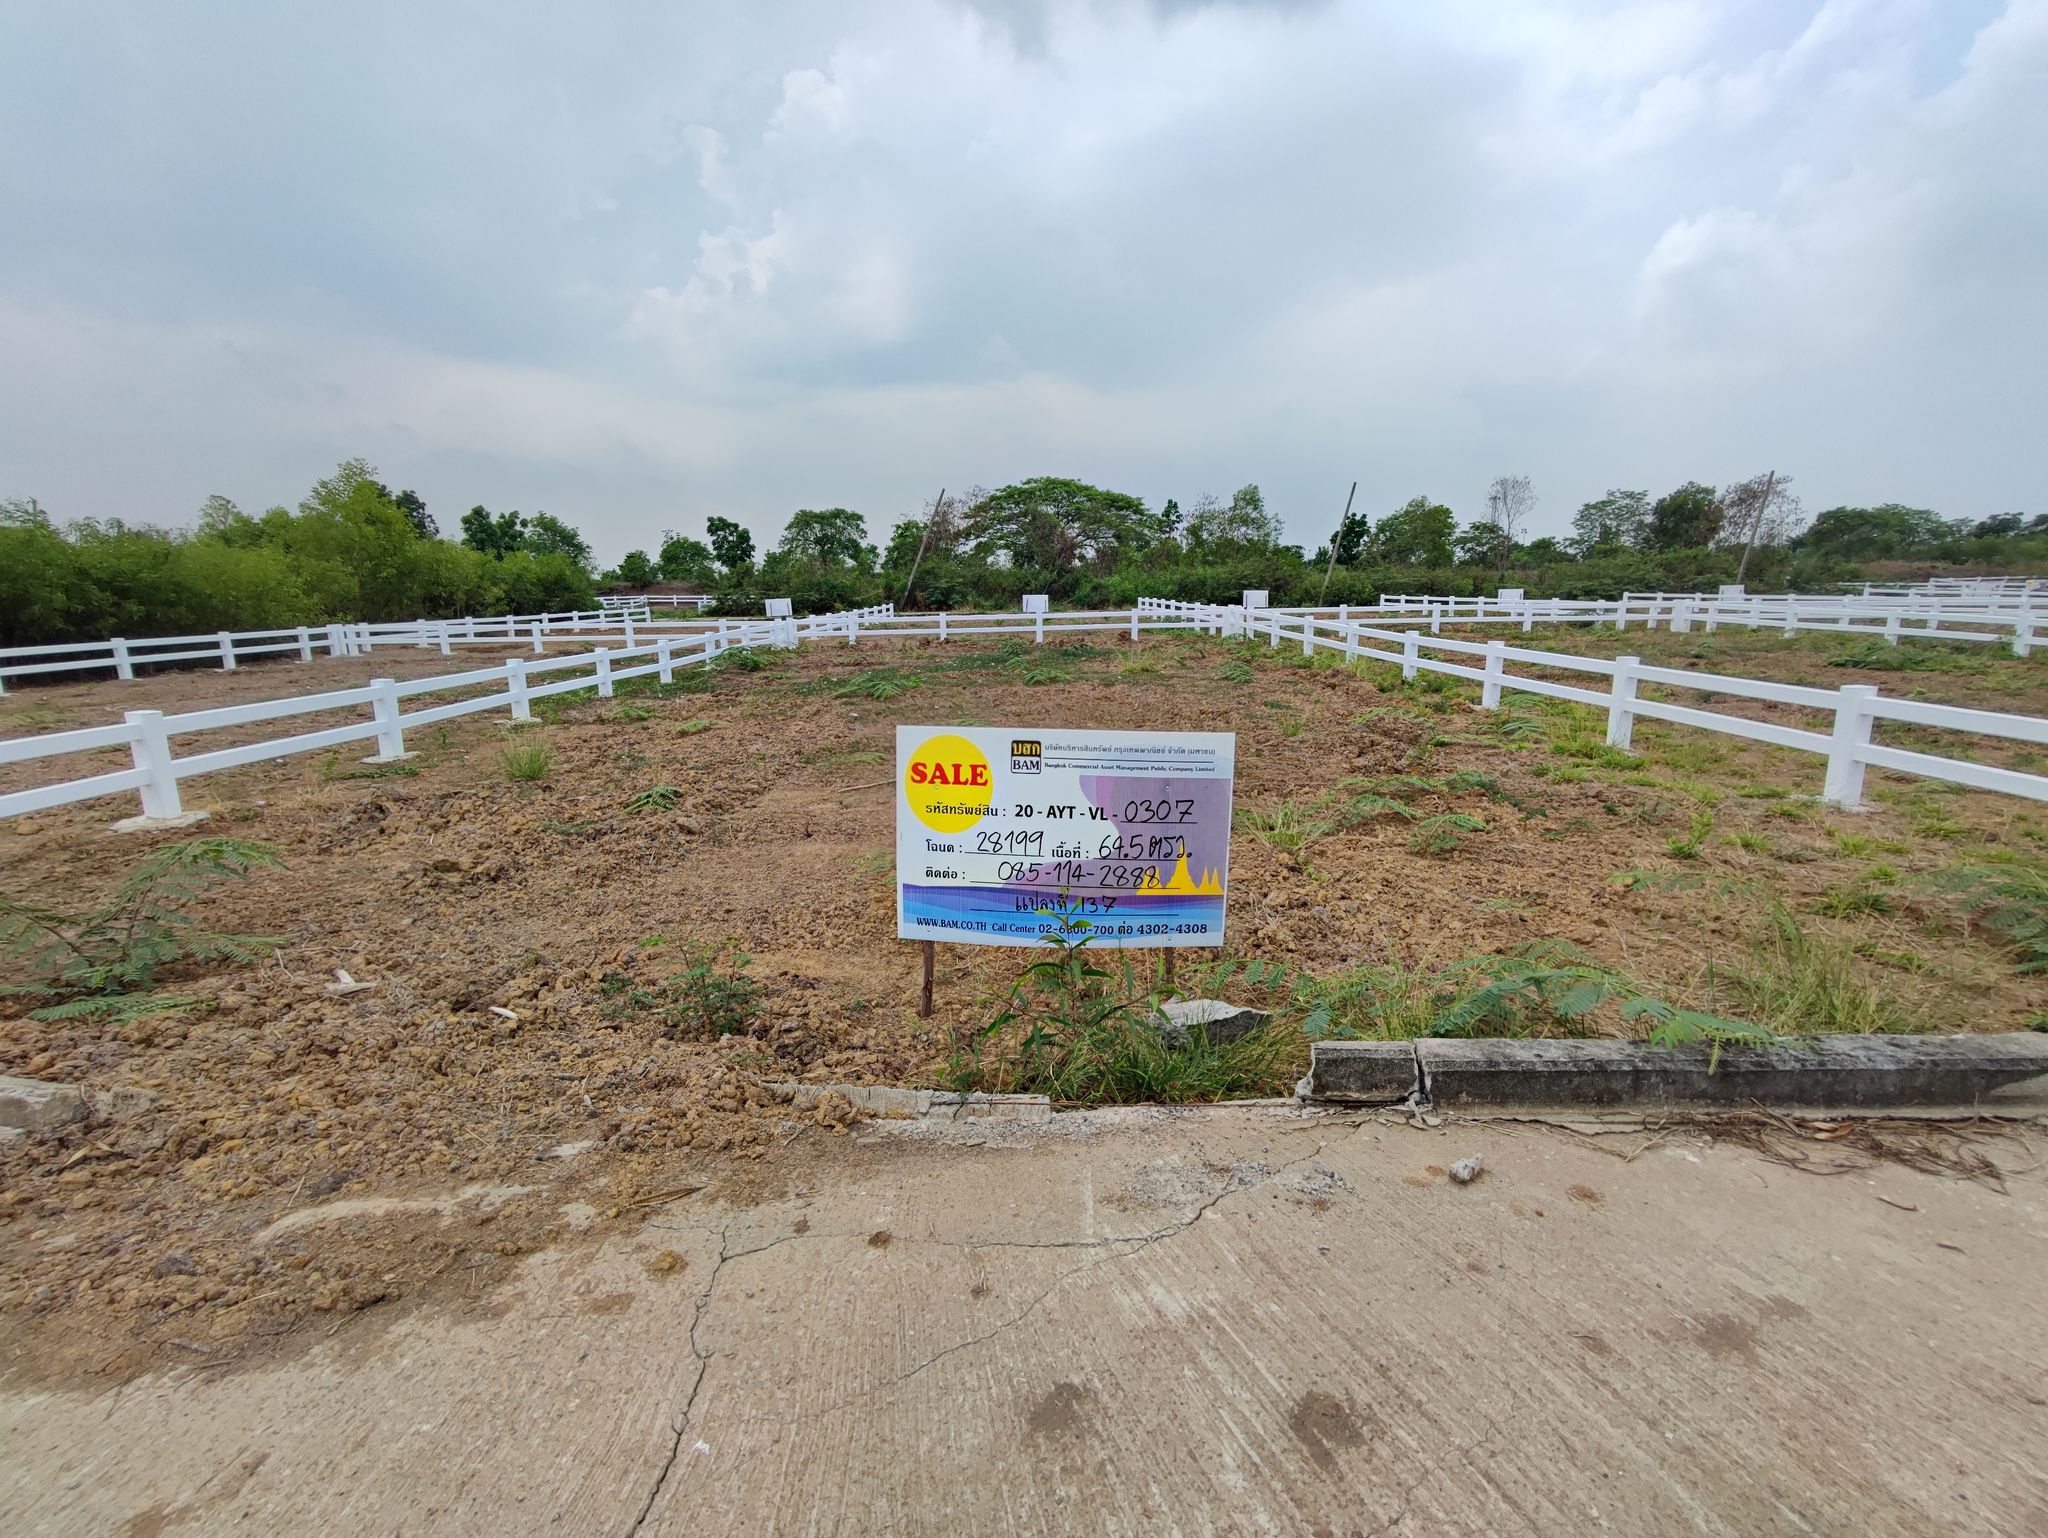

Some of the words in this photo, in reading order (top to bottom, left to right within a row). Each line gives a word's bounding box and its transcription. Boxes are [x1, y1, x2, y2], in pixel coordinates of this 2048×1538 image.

[1012, 742, 1040, 756] บสก
[910, 761, 989, 787] SALE
[1012, 759, 1040, 771] BAM
[925, 801, 998, 817] รหัสทรัพย์สิน
[1014, 804, 1034, 818] 20
[1046, 805, 1076, 819] AYT
[1088, 806, 1109, 821] VL
[1124, 799, 1195, 823] 0307
[925, 838, 955, 853] โฉนด
[976, 830, 1044, 857] 28199
[1051, 841, 1081, 858] เนื้อที่
[925, 866, 958, 879] ติดต่อ
[997, 859, 1161, 889] 085-114-2888
[1080, 895, 1117, 913] 137
[916, 917, 987, 931] WWW.BAM.CO.TH
[991, 923, 1007, 932] Call
[1009, 924, 1036, 933] Center
[1117, 921, 1133, 935] ต่อ
[1137, 924, 1208, 934] 4302-4308
